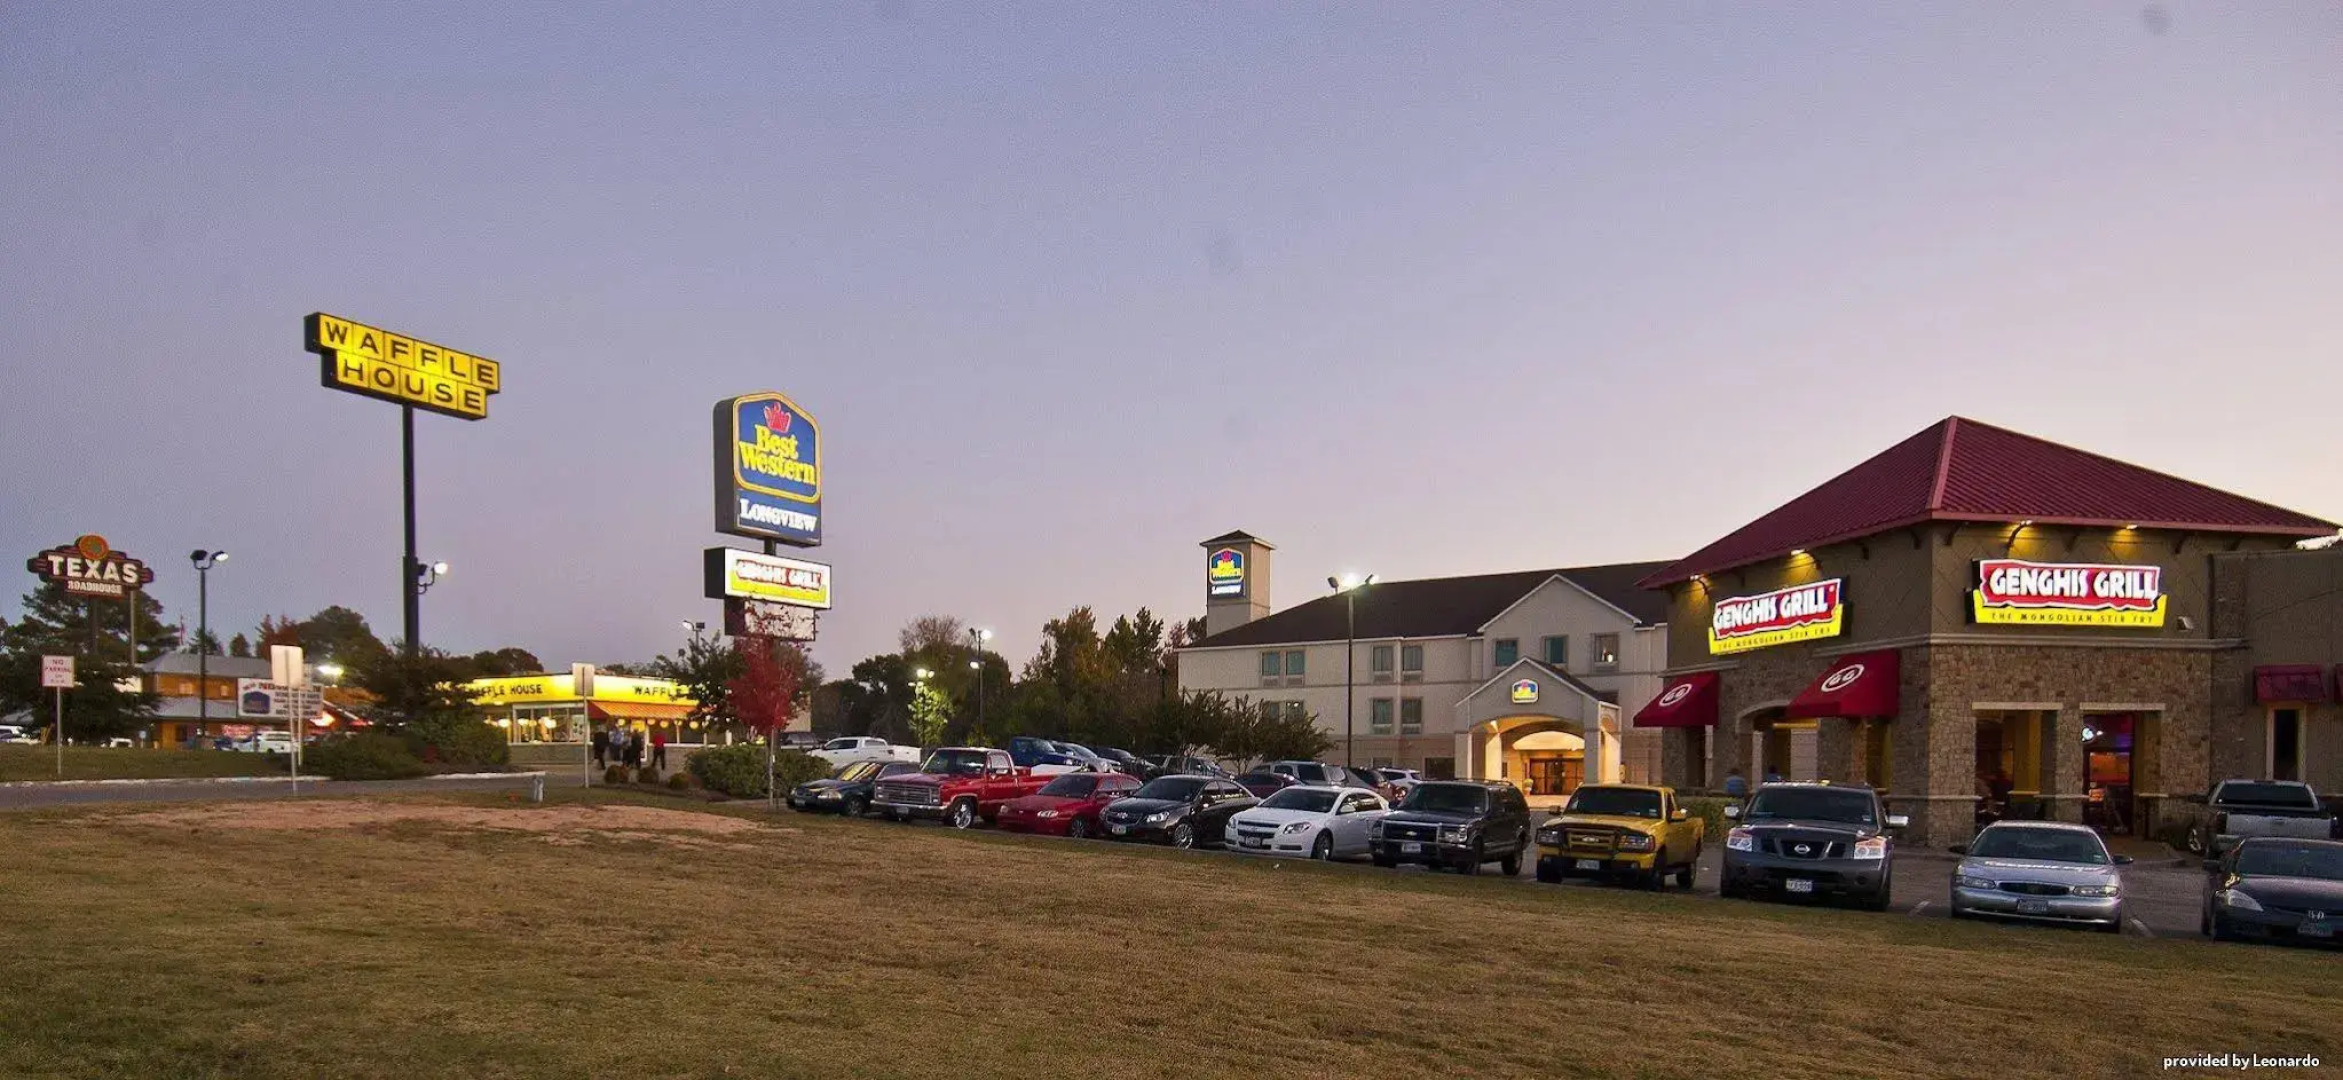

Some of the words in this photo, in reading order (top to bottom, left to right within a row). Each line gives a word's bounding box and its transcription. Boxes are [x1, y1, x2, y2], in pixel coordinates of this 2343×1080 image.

[324, 321, 495, 385] WAFFLE
[343, 359, 481, 410] HOUSE
[755, 424, 799, 460] Best
[739, 441, 816, 485] Western
[47, 554, 139, 584] TEXAS
[1989, 567, 2090, 598] GENGHIS
[2093, 570, 2158, 599] GRILL
[67, 580, 122, 594] ROADHOUSE
[1713, 596, 1777, 630] GENGHIS
[1780, 587, 1828, 619] GRILL
[1991, 612, 2012, 621] THE
[510, 684, 543, 695] HOUSE
